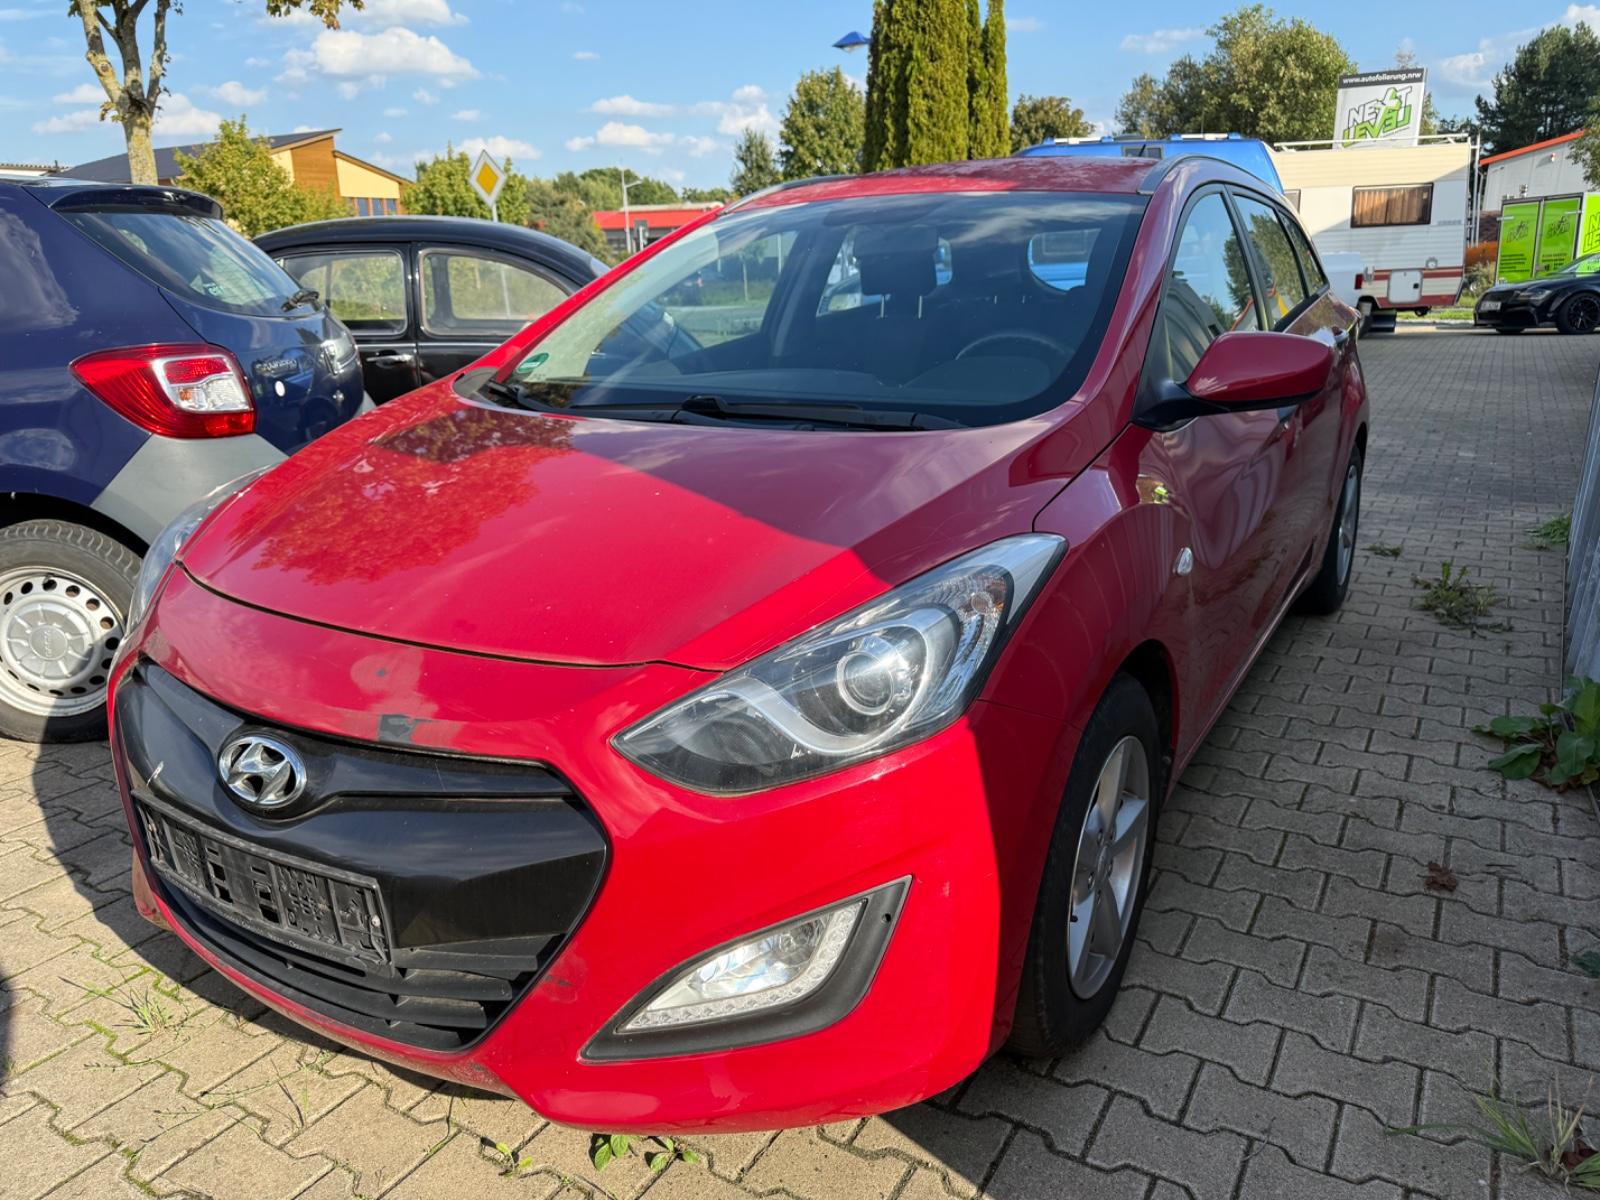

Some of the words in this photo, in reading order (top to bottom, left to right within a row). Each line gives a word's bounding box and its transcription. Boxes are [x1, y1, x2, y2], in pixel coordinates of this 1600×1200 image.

[1342, 72, 1422, 84] www.autofolierung.nrw
[1342, 104, 1413, 148] LEVEL
[1348, 85, 1413, 129] NEXT
